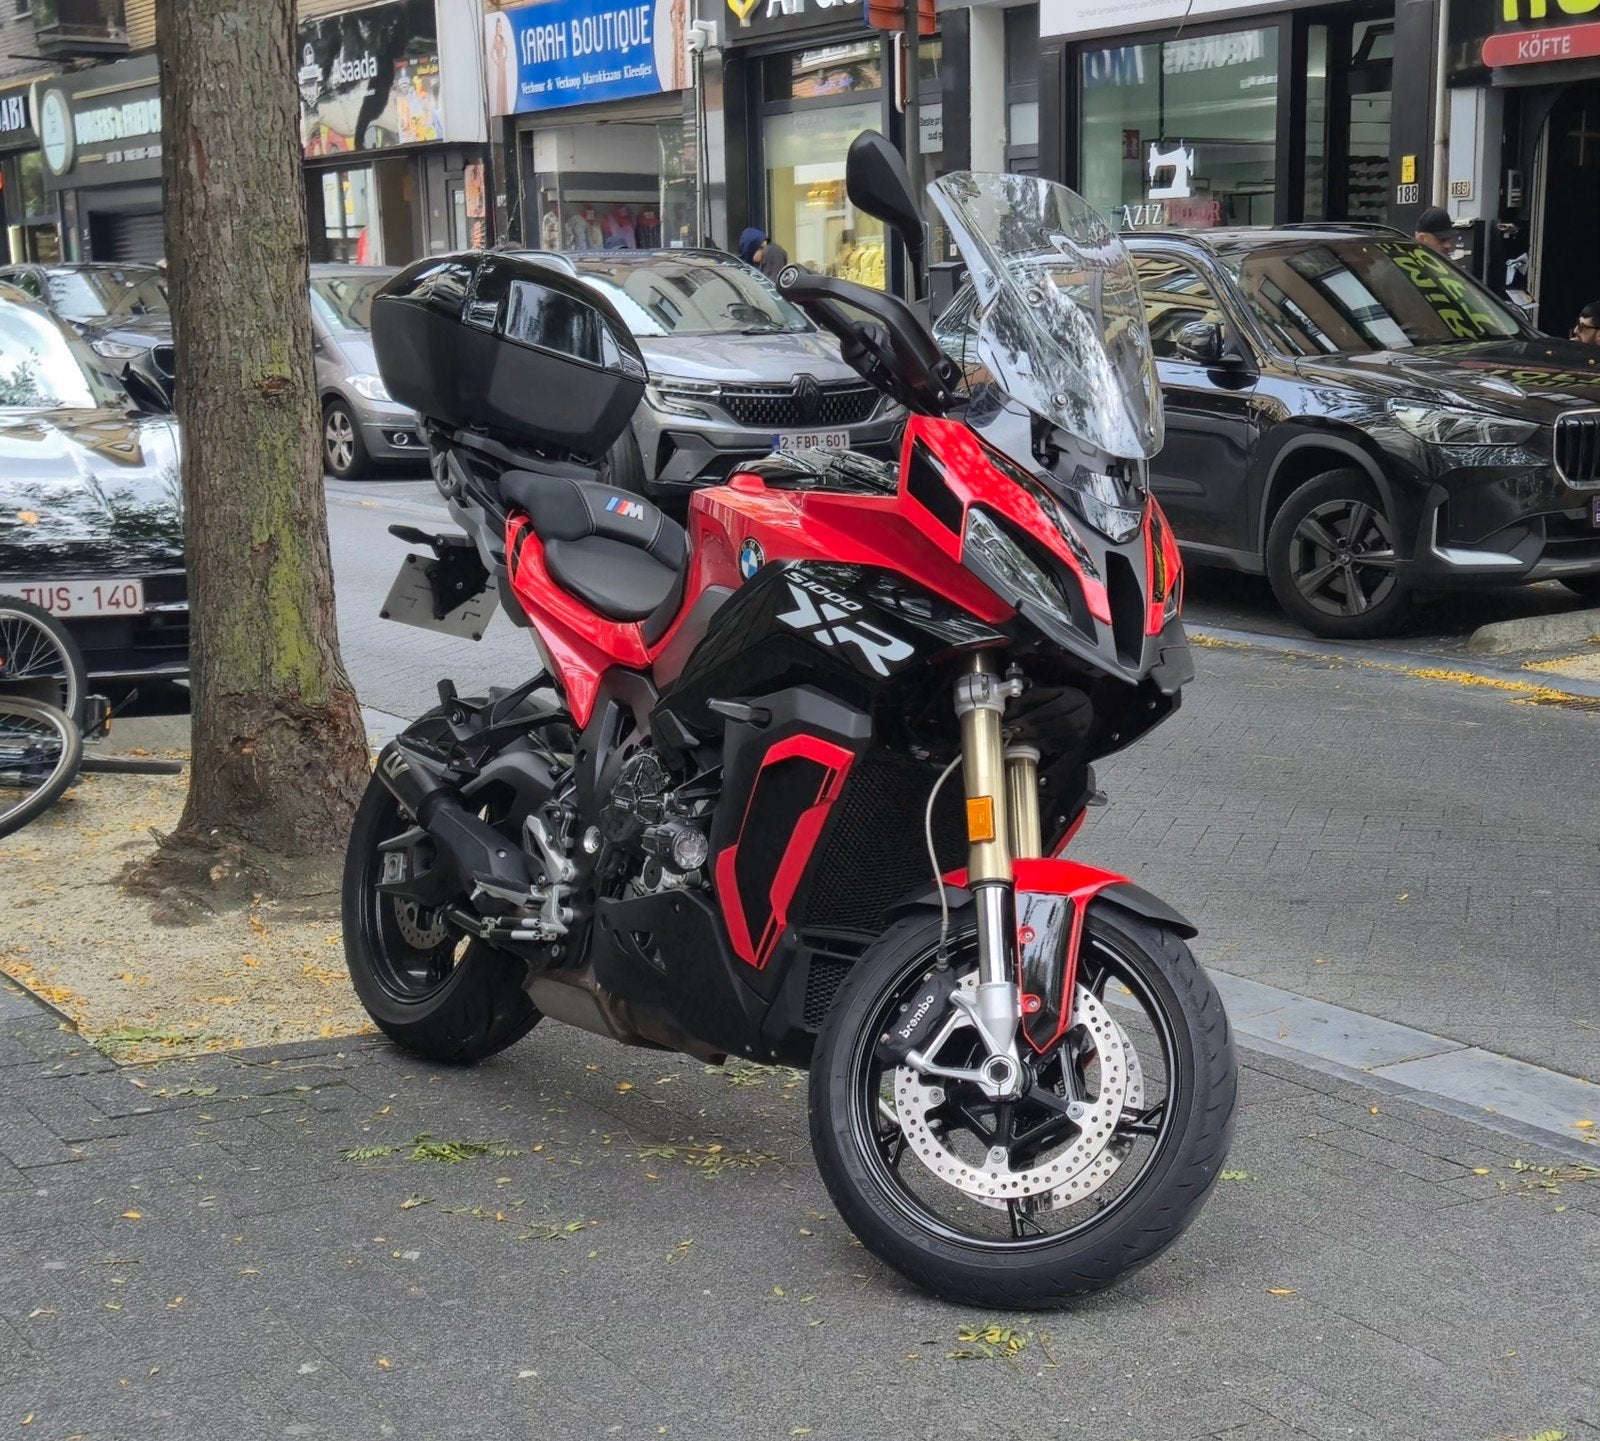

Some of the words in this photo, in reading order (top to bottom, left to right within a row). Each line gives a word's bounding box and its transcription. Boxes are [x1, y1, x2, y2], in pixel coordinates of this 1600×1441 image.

[521, 22, 567, 66] SARAH
[571, 4, 652, 56] BOUTIQUE
[1517, 33, 1571, 59] KÖFTE
[547, 78, 553, 91] &
[555, 75, 581, 90] Verkoop
[623, 63, 653, 79] Kleedjes
[0, 96, 26, 133] ABI
[1398, 185, 1418, 203] 188
[1121, 204, 1163, 231] AZIZ
[781, 434, 847, 450] 2-FBD-601
[784, 571, 864, 612] S1000
[775, 583, 915, 677] XR
[898, 995, 935, 1039] brembo
